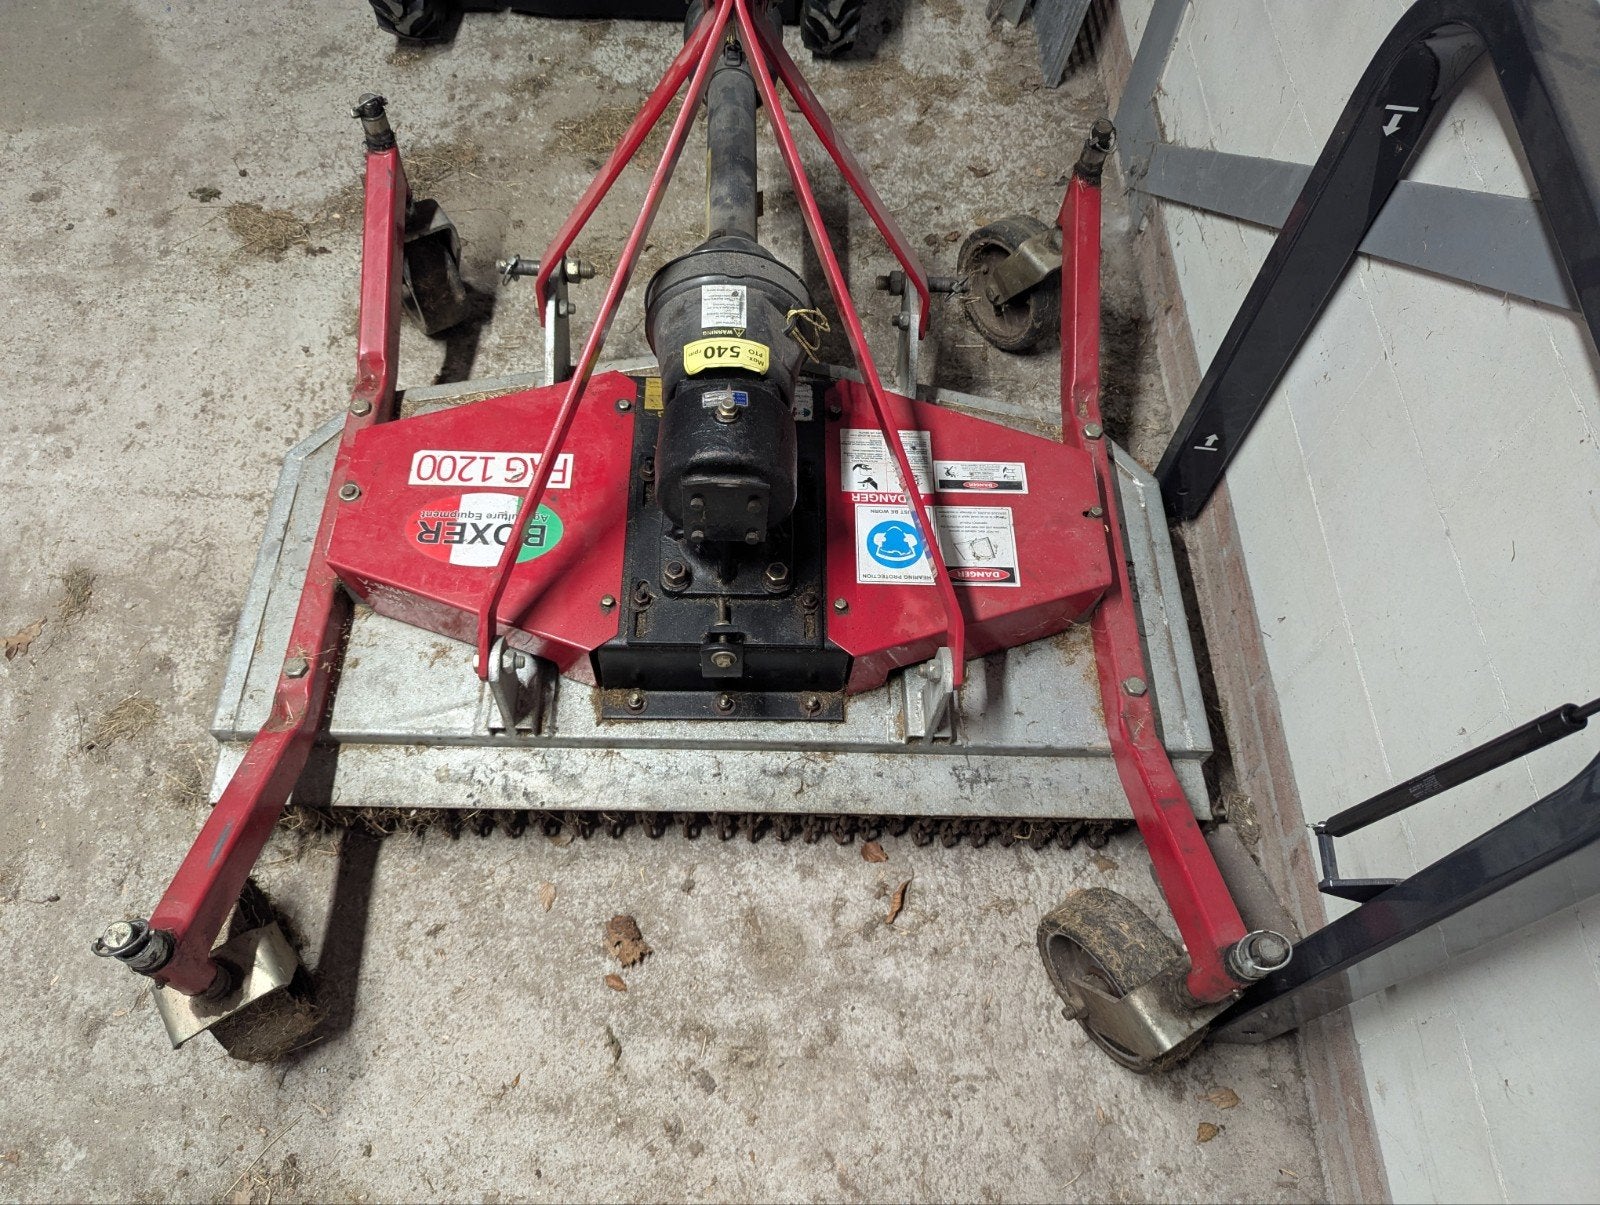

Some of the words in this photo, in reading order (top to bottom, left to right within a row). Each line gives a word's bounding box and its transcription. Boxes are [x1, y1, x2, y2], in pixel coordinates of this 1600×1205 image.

[704, 346, 741, 359] 540
[748, 348, 763, 357] PTO
[416, 454, 495, 482] 1200
[851, 493, 907, 503] DANGER
[421, 510, 482, 521] Equipment
[487, 512, 548, 522] Agulture
[416, 521, 547, 547] BOXER
